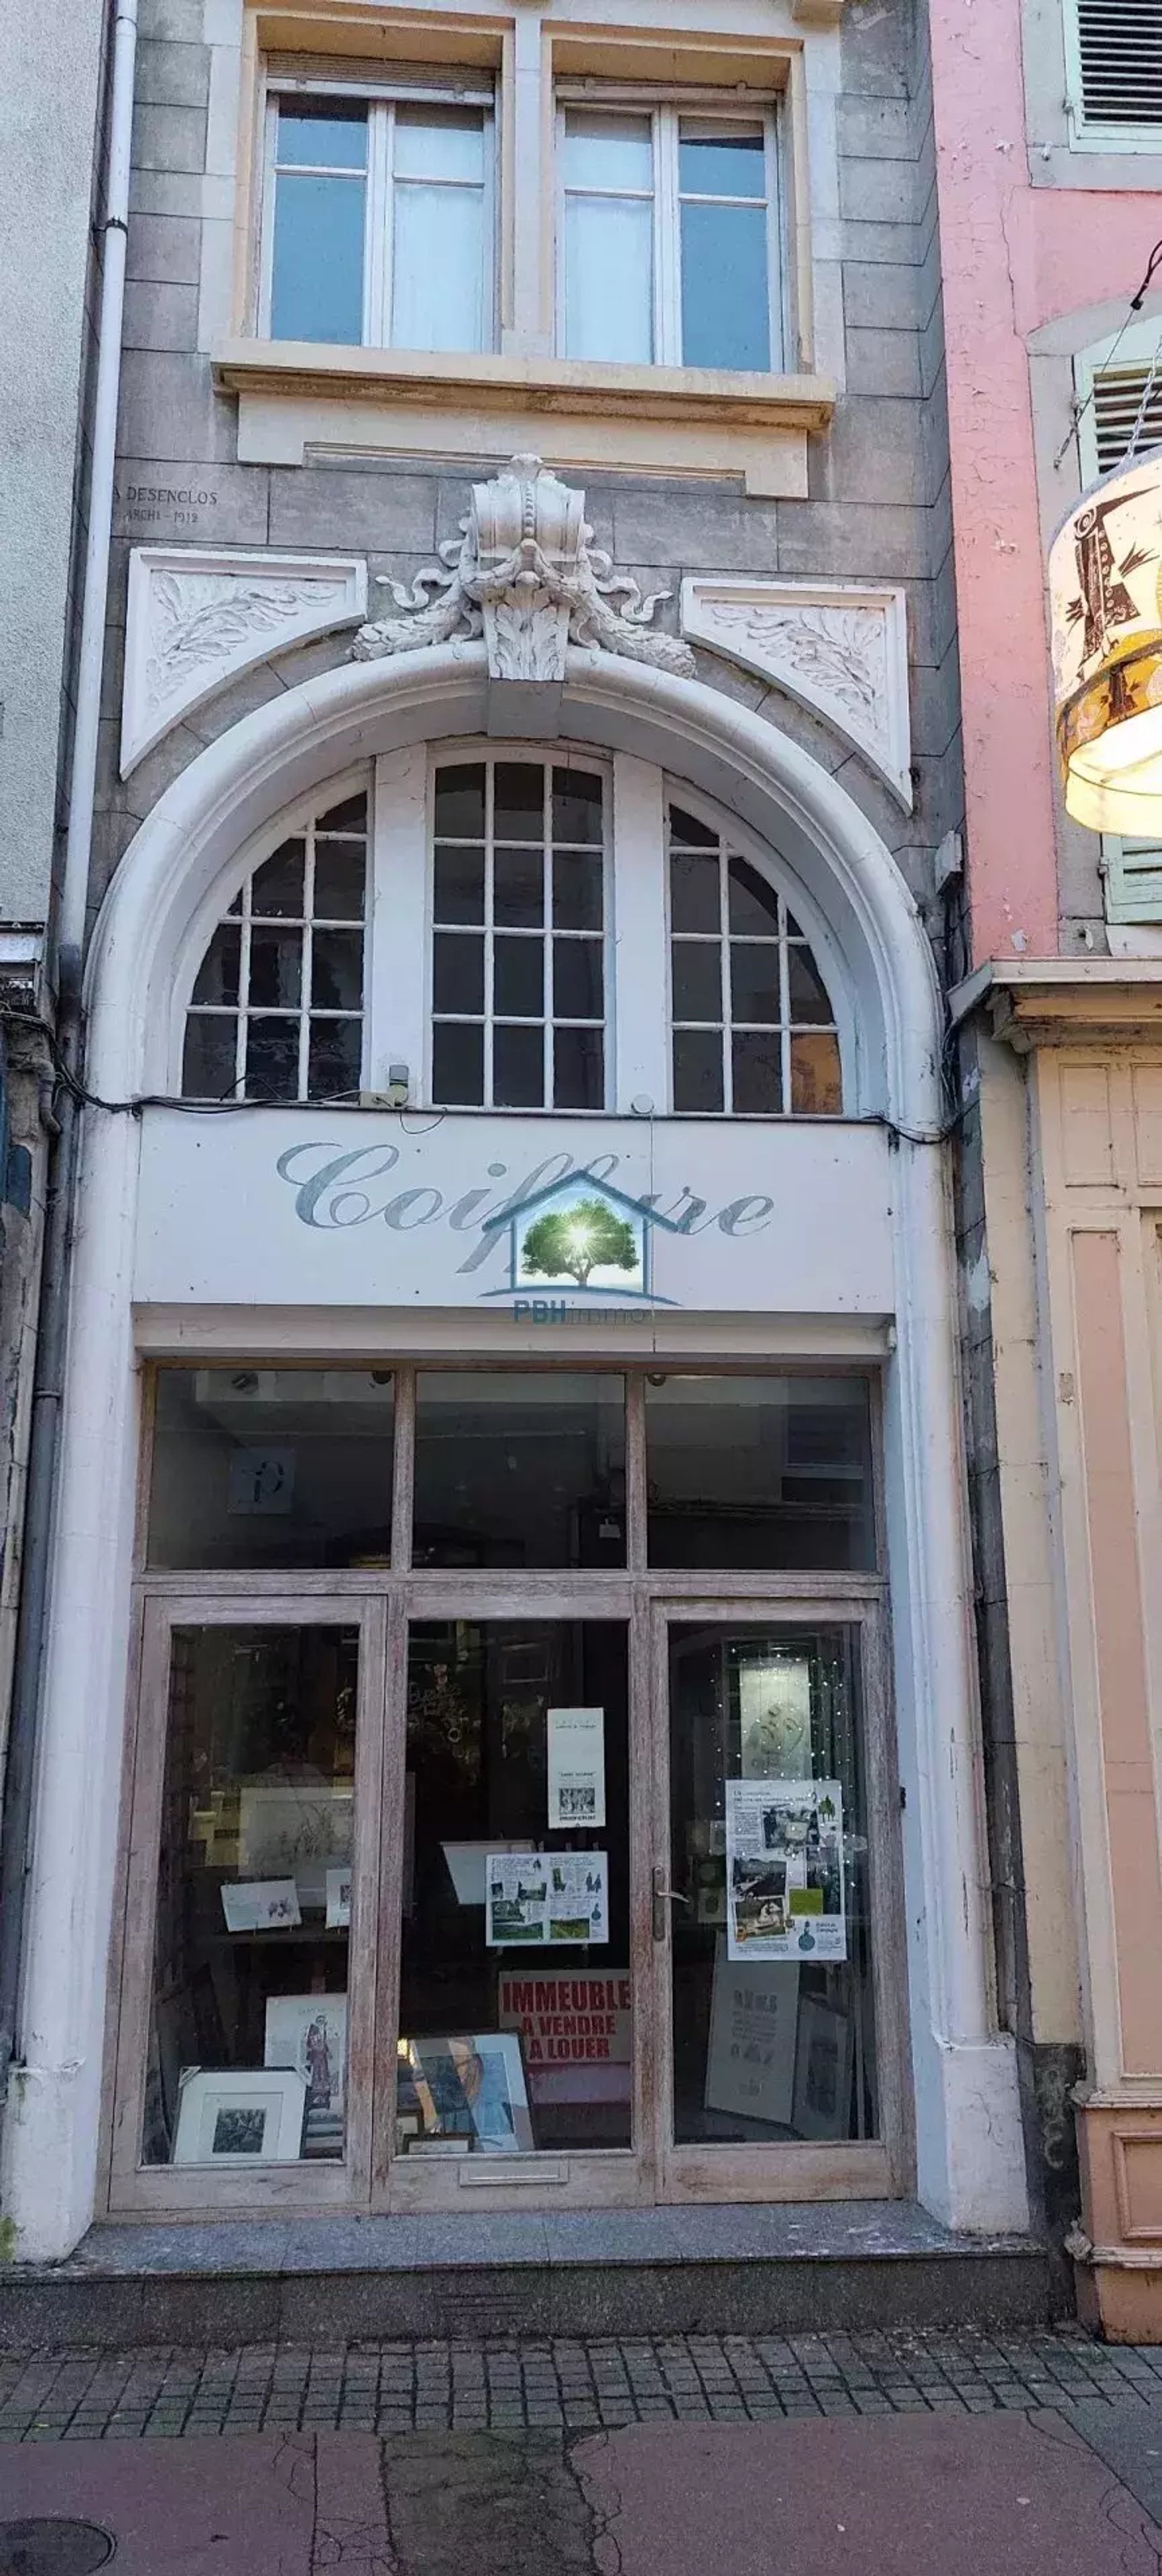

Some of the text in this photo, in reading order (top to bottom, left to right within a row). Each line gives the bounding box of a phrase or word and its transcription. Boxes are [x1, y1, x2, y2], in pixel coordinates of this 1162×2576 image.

[127, 487, 218, 505] DESENCLOS
[276, 1142, 775, 1274] Coifre
[503, 1981, 631, 2013] IMMEUBLE
[520, 2015, 616, 2037] A VENDRE
[529, 2038, 609, 2060] A LOUER
